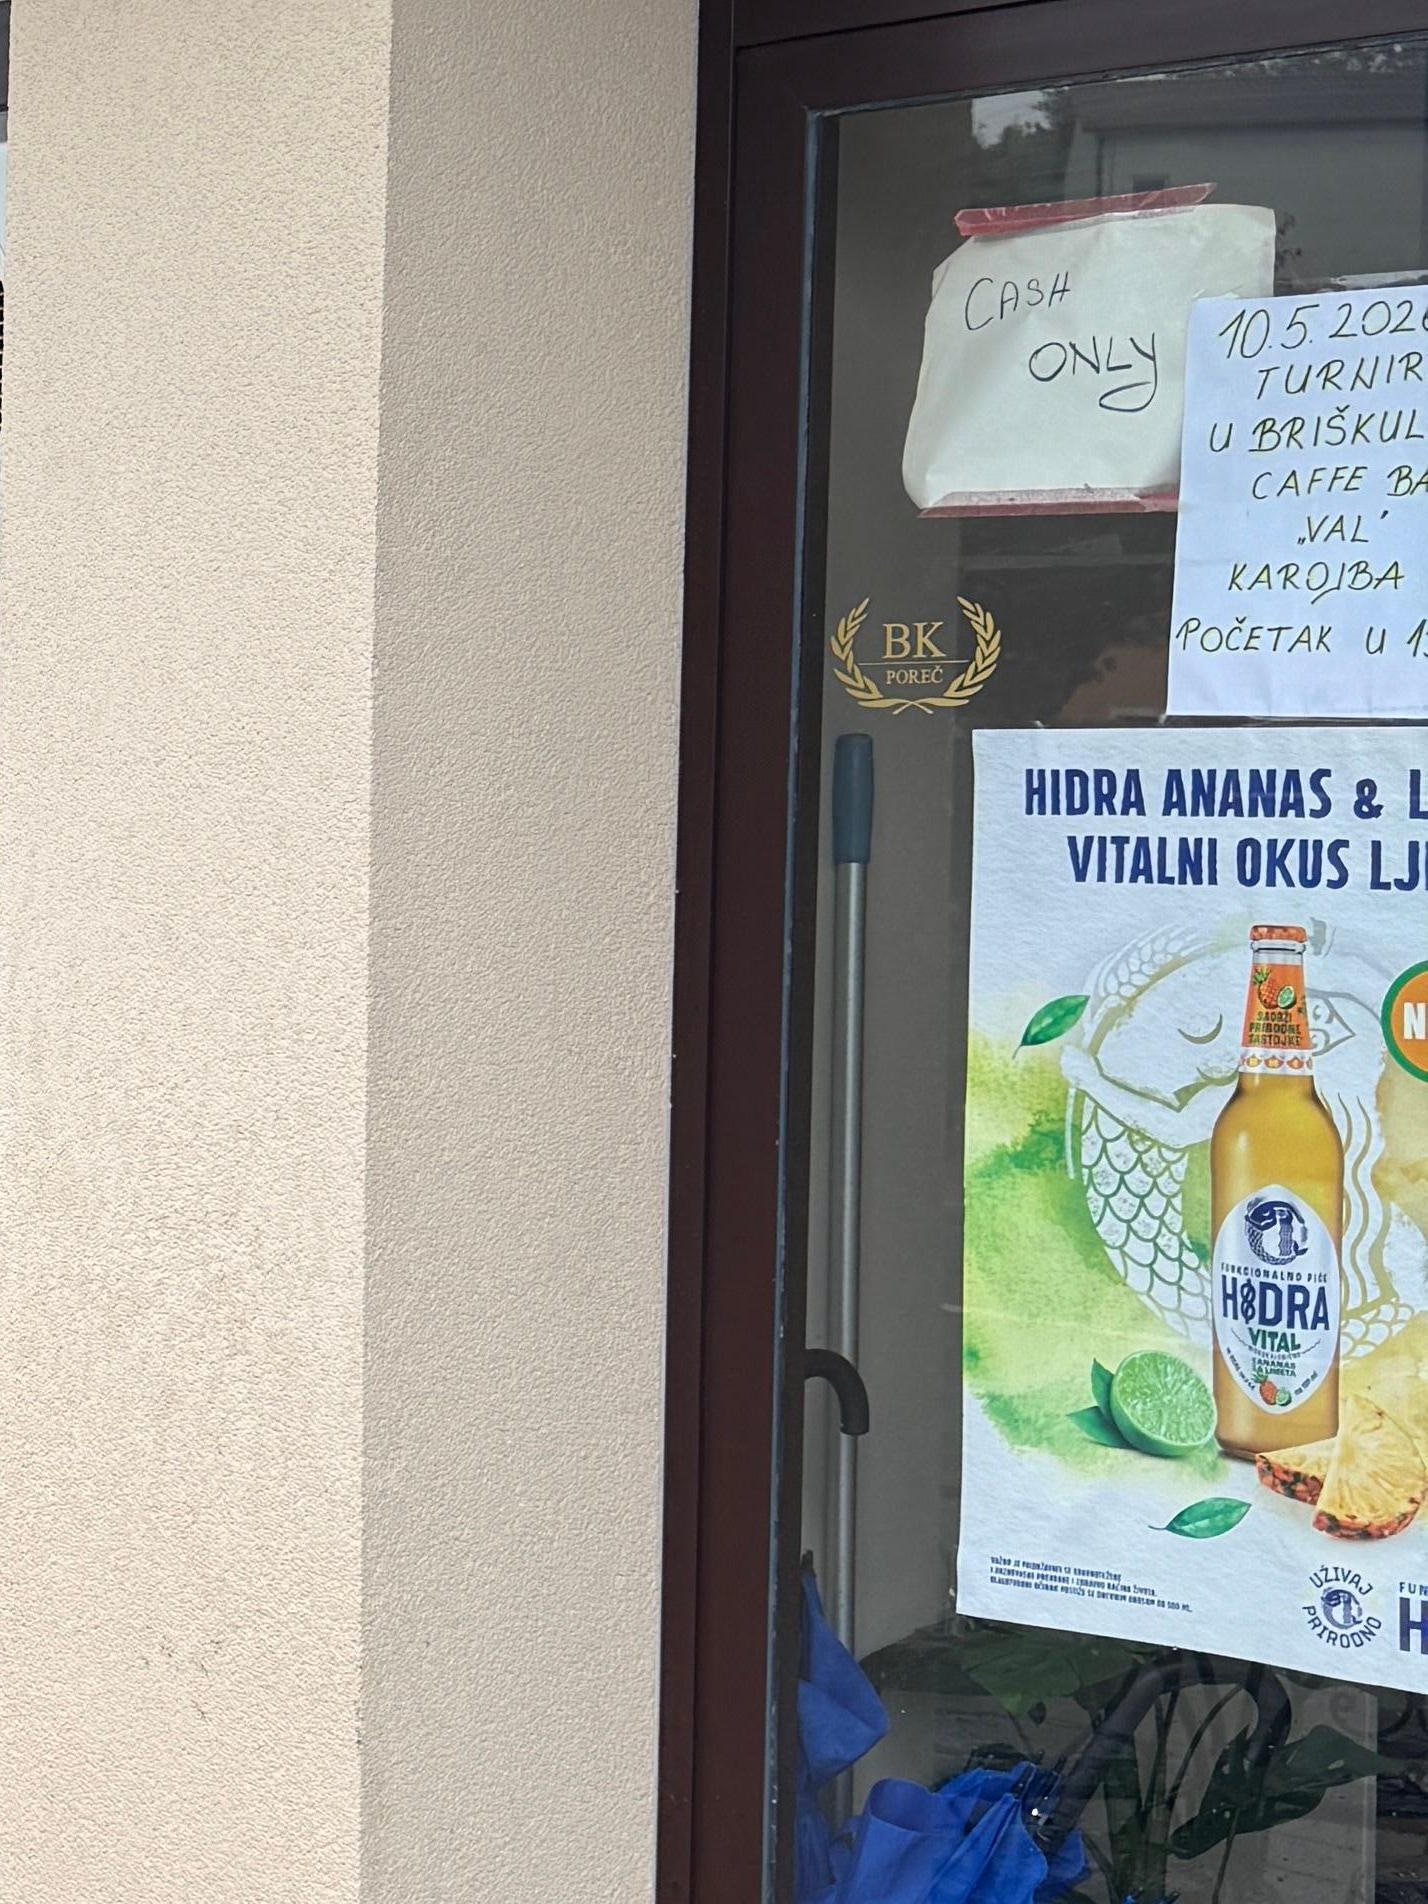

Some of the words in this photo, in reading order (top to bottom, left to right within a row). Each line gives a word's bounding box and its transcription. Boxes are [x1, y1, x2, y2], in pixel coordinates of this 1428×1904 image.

[965, 271, 1070, 330] CASH
[1029, 332, 1158, 412] ONLY
[1257, 352, 1423, 400] TURNIR
[1209, 423, 1233, 452] U
[1248, 404, 1424, 452] BRIŠKUL
[1252, 466, 1368, 499] CAFFE
[1228, 560, 1404, 604] KAROJBA
[881, 621, 946, 659] BK
[1175, 616, 1332, 653] POČETAK
[1365, 626, 1386, 654] U
[1407, 618, 1428, 657] 1
[886, 665, 943, 684] POREČ
[1025, 768, 1146, 816] HIDRA
[1162, 768, 1332, 819] ANANAS
[1353, 778, 1384, 819] &
[1067, 835, 1218, 886] VITALNI
[1237, 837, 1349, 890] OKUS
[1370, 840, 1428, 891] LJ
[1248, 1327, 1301, 1353] VITAL
[1309, 1564, 1373, 1595] UŽIVAJ
[1302, 1606, 1382, 1648] PRIRODNO
